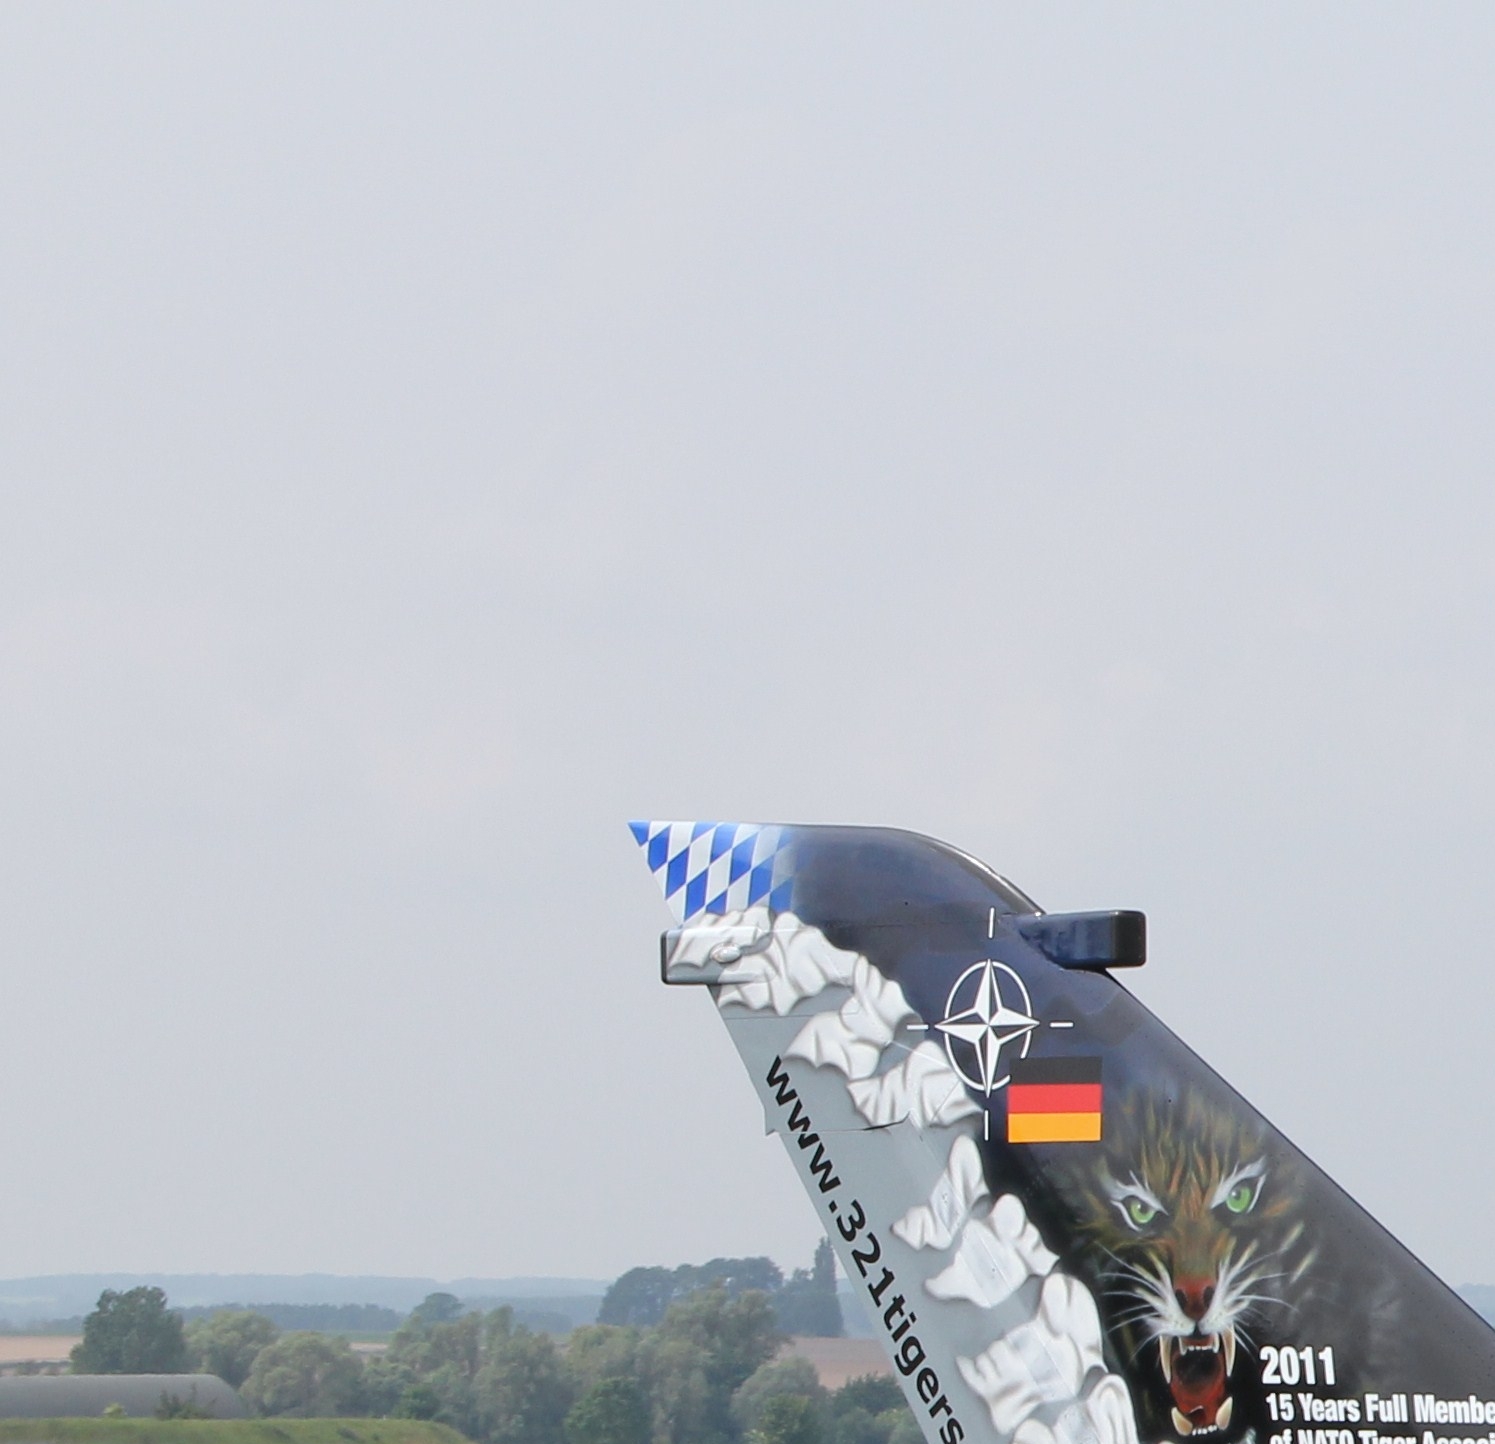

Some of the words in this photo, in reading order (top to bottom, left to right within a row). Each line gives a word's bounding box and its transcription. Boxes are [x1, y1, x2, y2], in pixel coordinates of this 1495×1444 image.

[1259, 1345, 1336, 1385] 2011
[1266, 1393, 1294, 1421] 15
[1298, 1392, 1361, 1423] Years
[1365, 1394, 1408, 1423] Full
